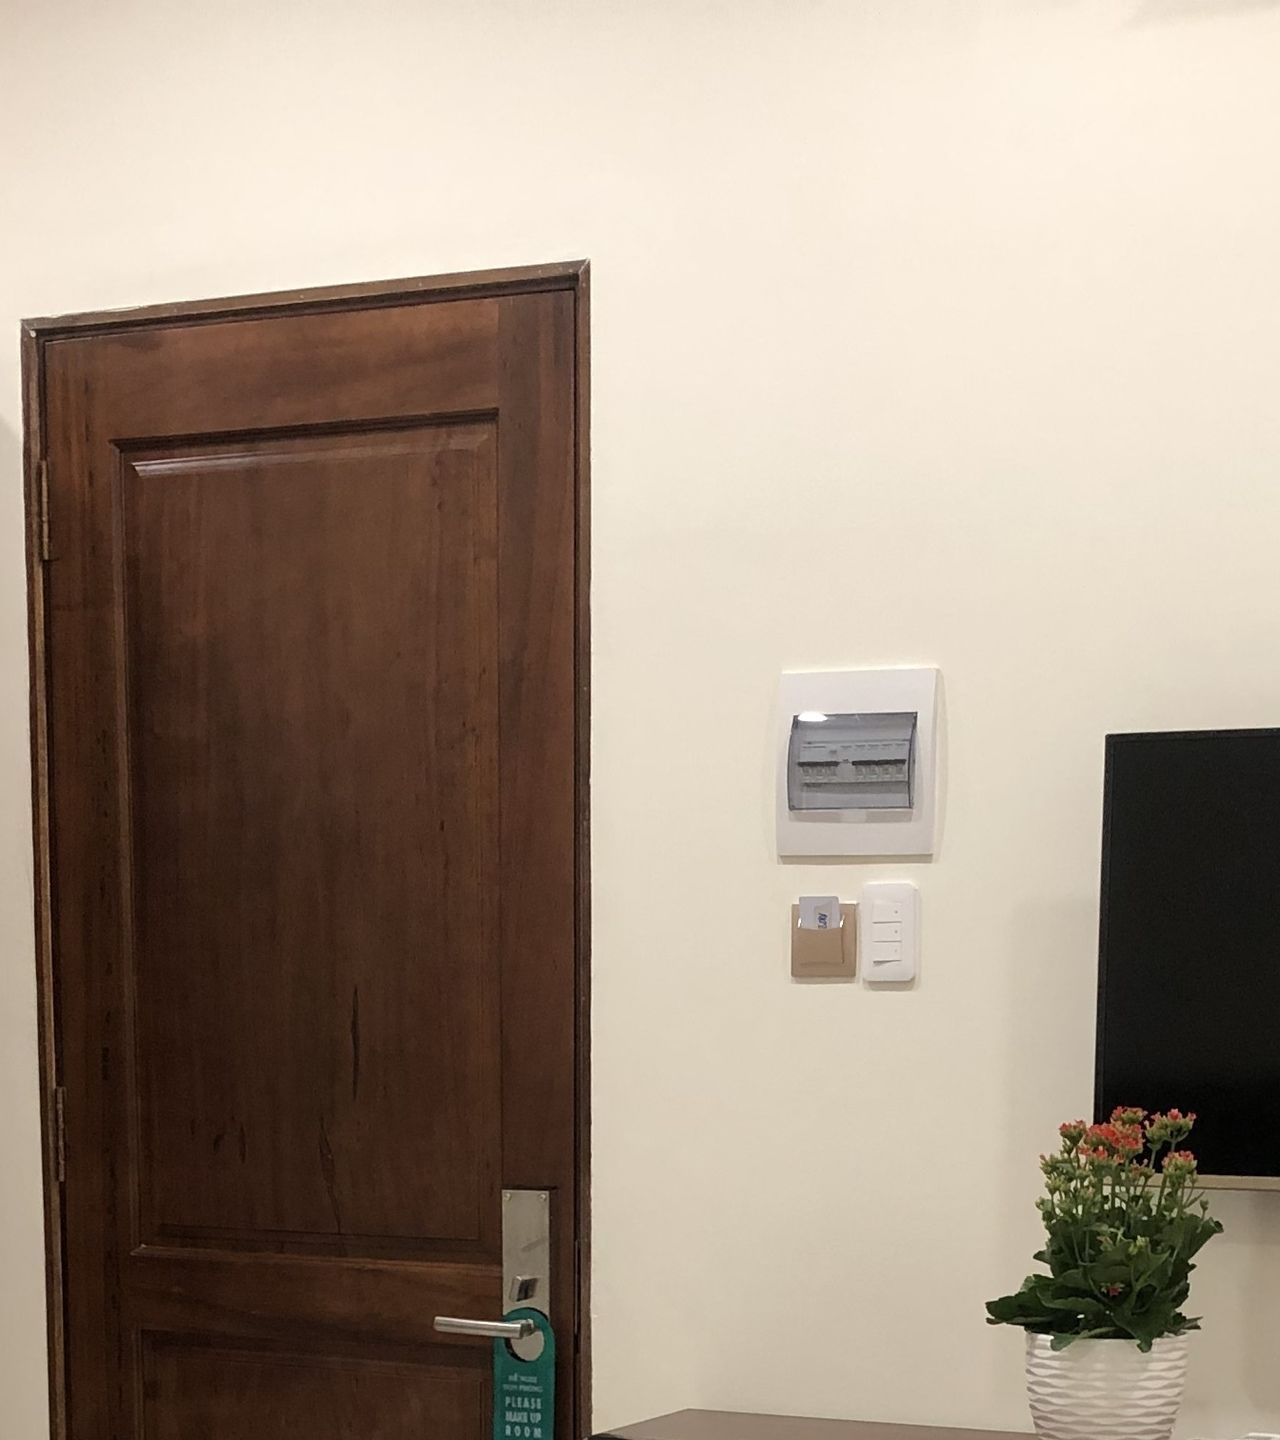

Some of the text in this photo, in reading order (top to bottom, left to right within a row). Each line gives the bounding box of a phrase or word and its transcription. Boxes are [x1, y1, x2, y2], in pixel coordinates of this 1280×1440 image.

[505, 1396, 542, 1410] PLEASE
[505, 1411, 542, 1424] MAKE UP
[505, 1424, 542, 1439] ROOM
